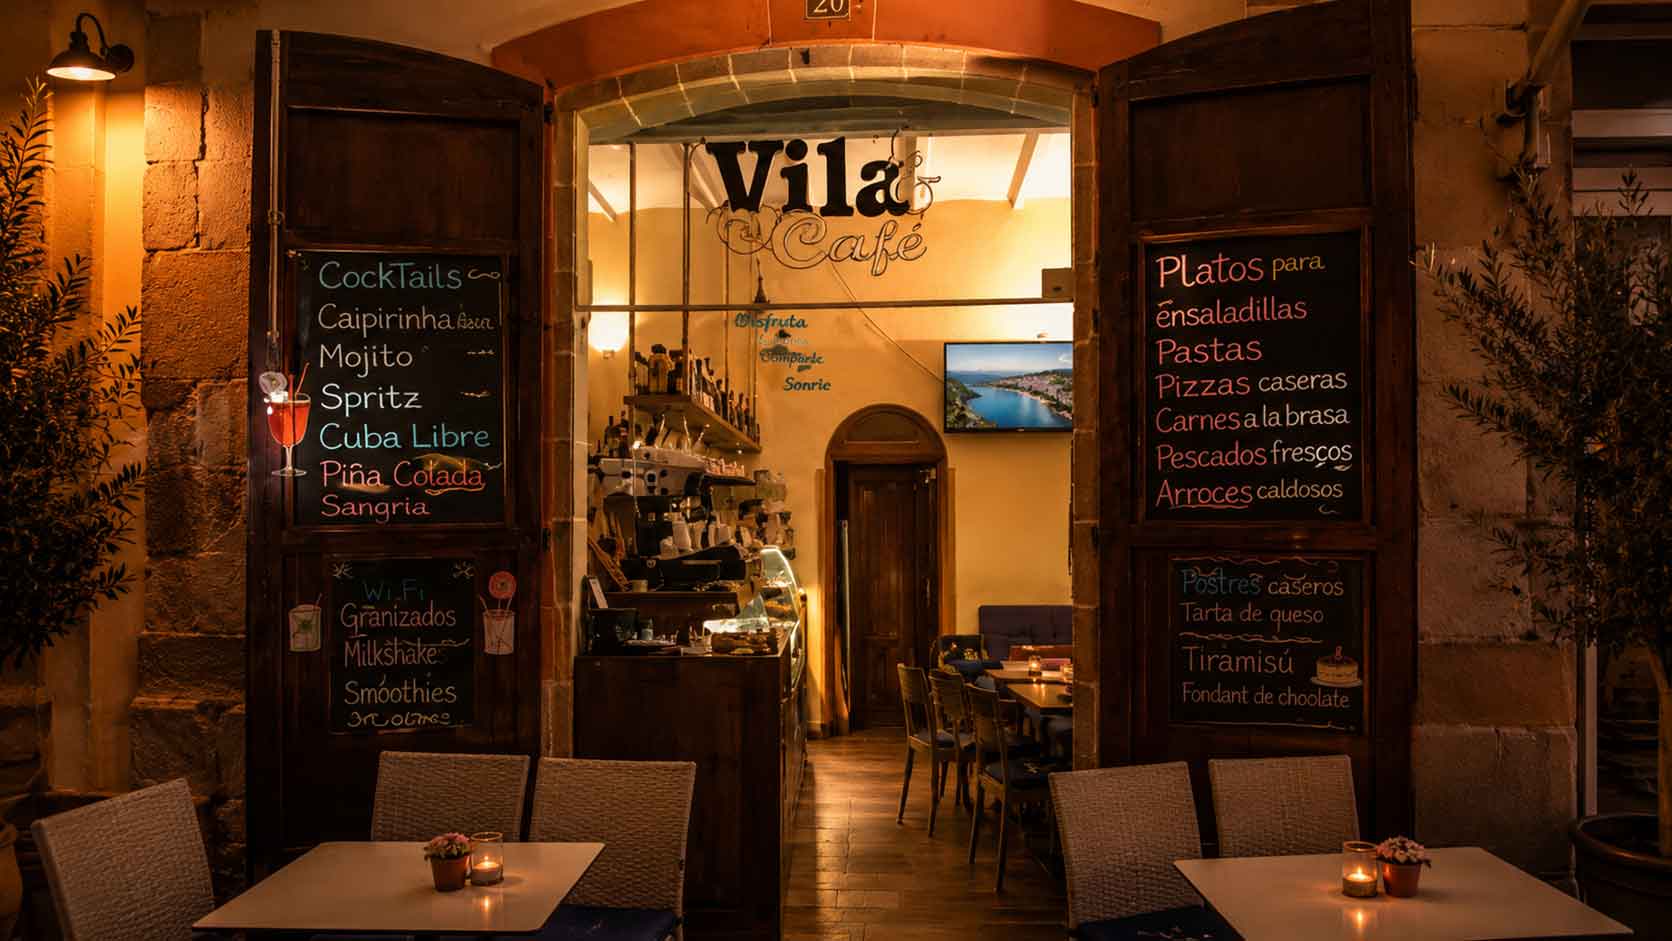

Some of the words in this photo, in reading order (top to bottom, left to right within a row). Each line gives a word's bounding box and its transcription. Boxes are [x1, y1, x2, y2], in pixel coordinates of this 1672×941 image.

[705, 136, 911, 217] Vila
[771, 209, 927, 276] Café
[1155, 252, 1265, 288] Platos
[1272, 255, 1325, 280] para
[318, 303, 455, 338] Caipirinha
[319, 343, 413, 378] Mojito
[1155, 337, 1263, 365] Pastas
[320, 383, 423, 417] Spritz
[1155, 373, 1250, 399] Pizzas
[1258, 372, 1348, 392] caseras
[1156, 407, 1241, 433] Carnes
[1243, 413, 1260, 428] a
[1262, 404, 1282, 427] la
[1286, 403, 1350, 427] brasa
[319, 422, 402, 450] Cuba
[412, 422, 491, 448] Libre
[1156, 440, 1267, 471] Pescados
[319, 459, 384, 487] Piña
[393, 459, 486, 487] Colada
[1155, 479, 1253, 507] Arroces
[1256, 478, 1344, 499] caldosos
[320, 494, 431, 524] Sangria
[1181, 567, 1261, 594] Postres
[340, 600, 457, 636] Granizados
[1179, 602, 1232, 622] Tarta
[1240, 602, 1263, 622] de
[1270, 608, 1324, 632] queso
[1181, 646, 1294, 674] Tiramisú
[1182, 682, 1249, 704] Fondant
[1254, 685, 1274, 704] de
